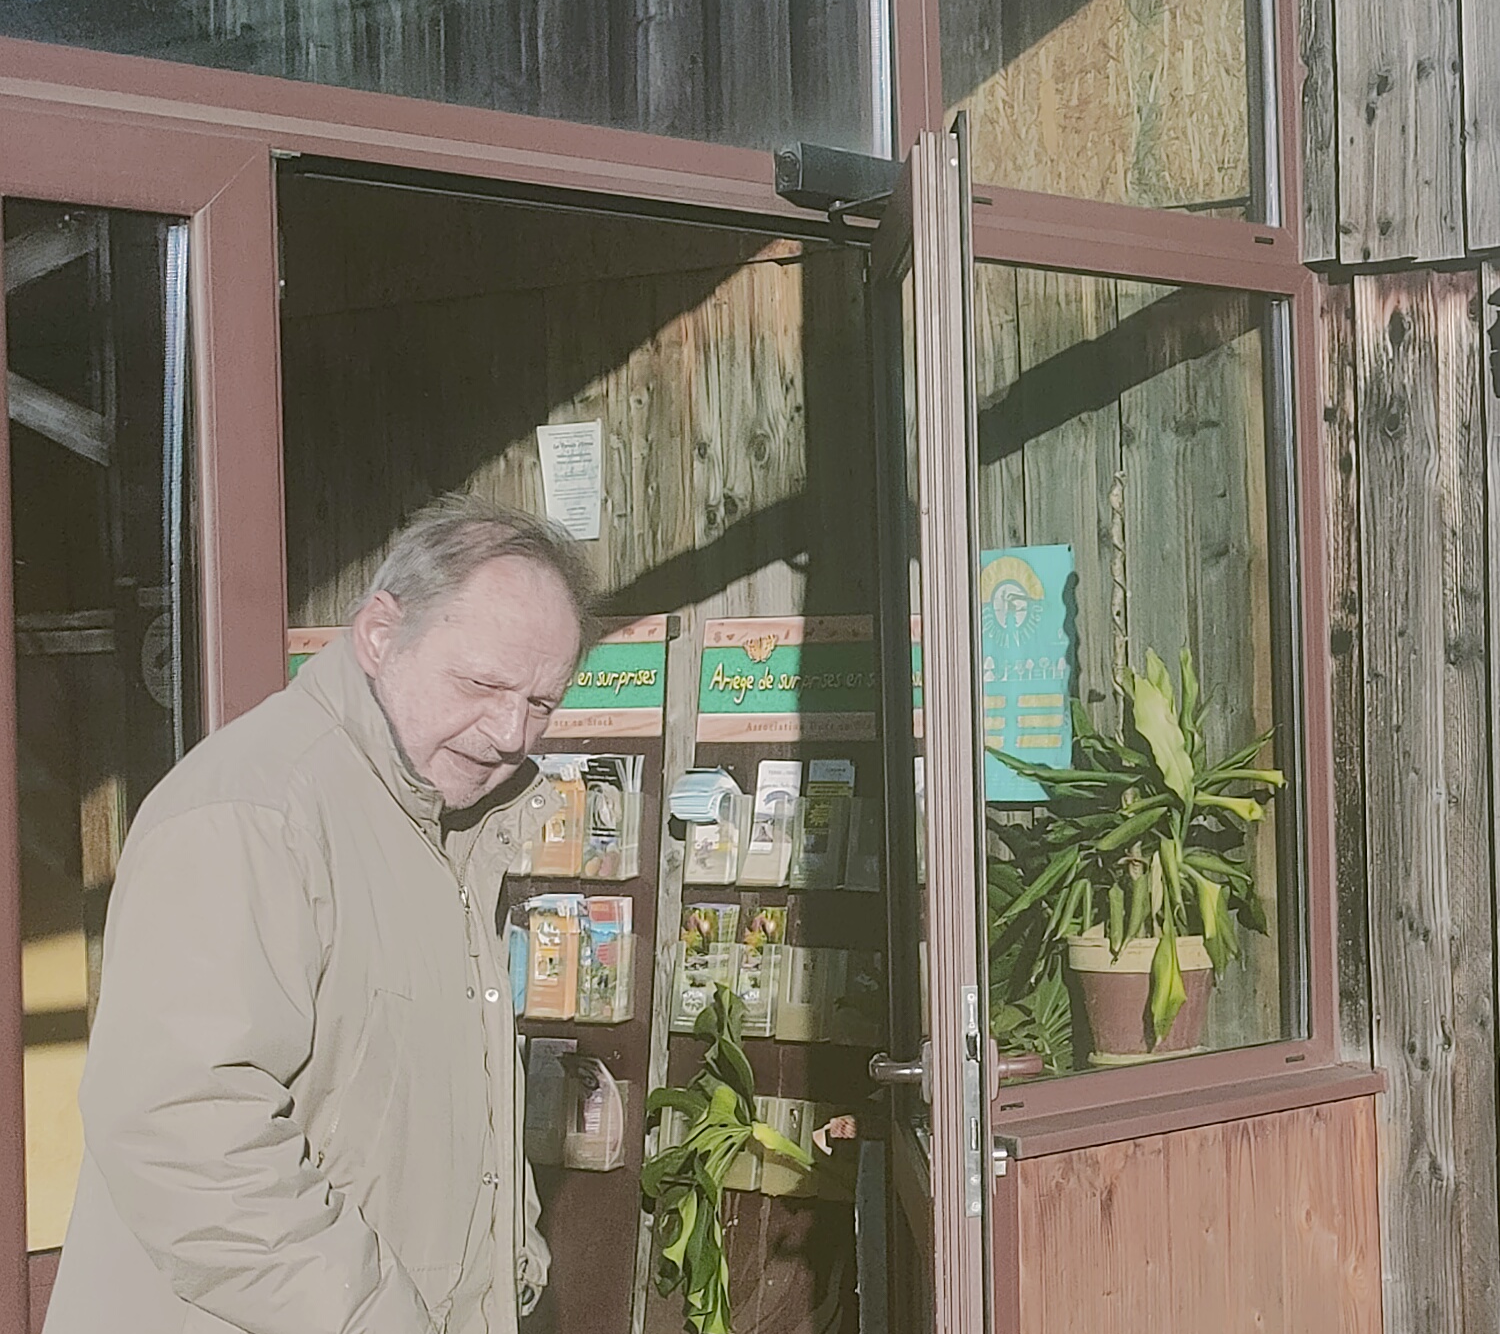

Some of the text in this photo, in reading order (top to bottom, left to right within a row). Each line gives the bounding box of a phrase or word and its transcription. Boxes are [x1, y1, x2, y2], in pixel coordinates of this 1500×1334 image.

[577, 671, 592, 687] en
[596, 668, 657, 694] surprises
[708, 662, 754, 704] Ariège
[758, 666, 774, 690] de
[777, 673, 842, 698] surprises
[846, 673, 864, 688] en
[746, 722, 805, 732] Associati
